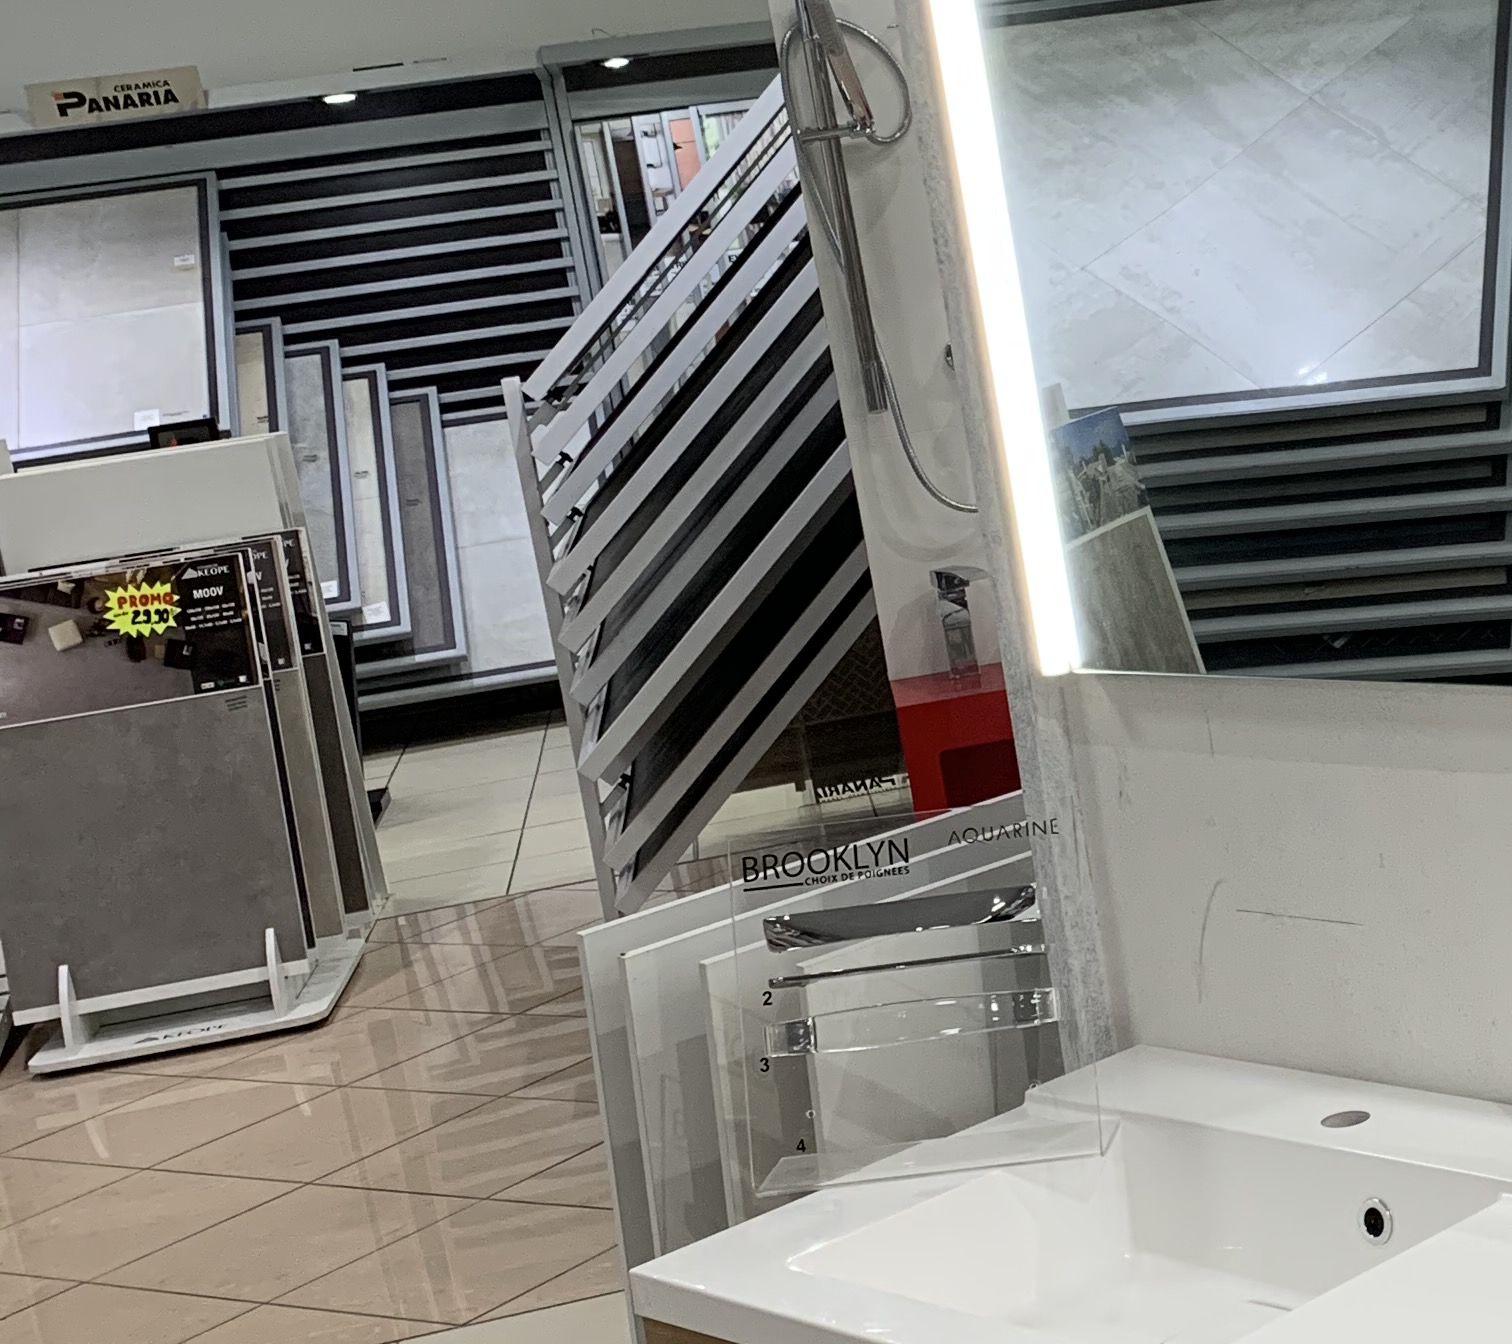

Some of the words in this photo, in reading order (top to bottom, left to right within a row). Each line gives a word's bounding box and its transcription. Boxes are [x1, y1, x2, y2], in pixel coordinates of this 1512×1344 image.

[113, 79, 171, 93] CERAMICA
[53, 88, 179, 117] PANARIA
[117, 592, 174, 609] PROMO
[192, 586, 224, 599] MOOV
[948, 818, 1060, 845] AQUARINE
[742, 838, 910, 883] BROOKLYN
[805, 874, 838, 888] CHOIX
[841, 871, 856, 882] DE
[762, 991, 773, 1006] 2
[759, 1057, 770, 1073] 3
[796, 1139, 806, 1152] 4
